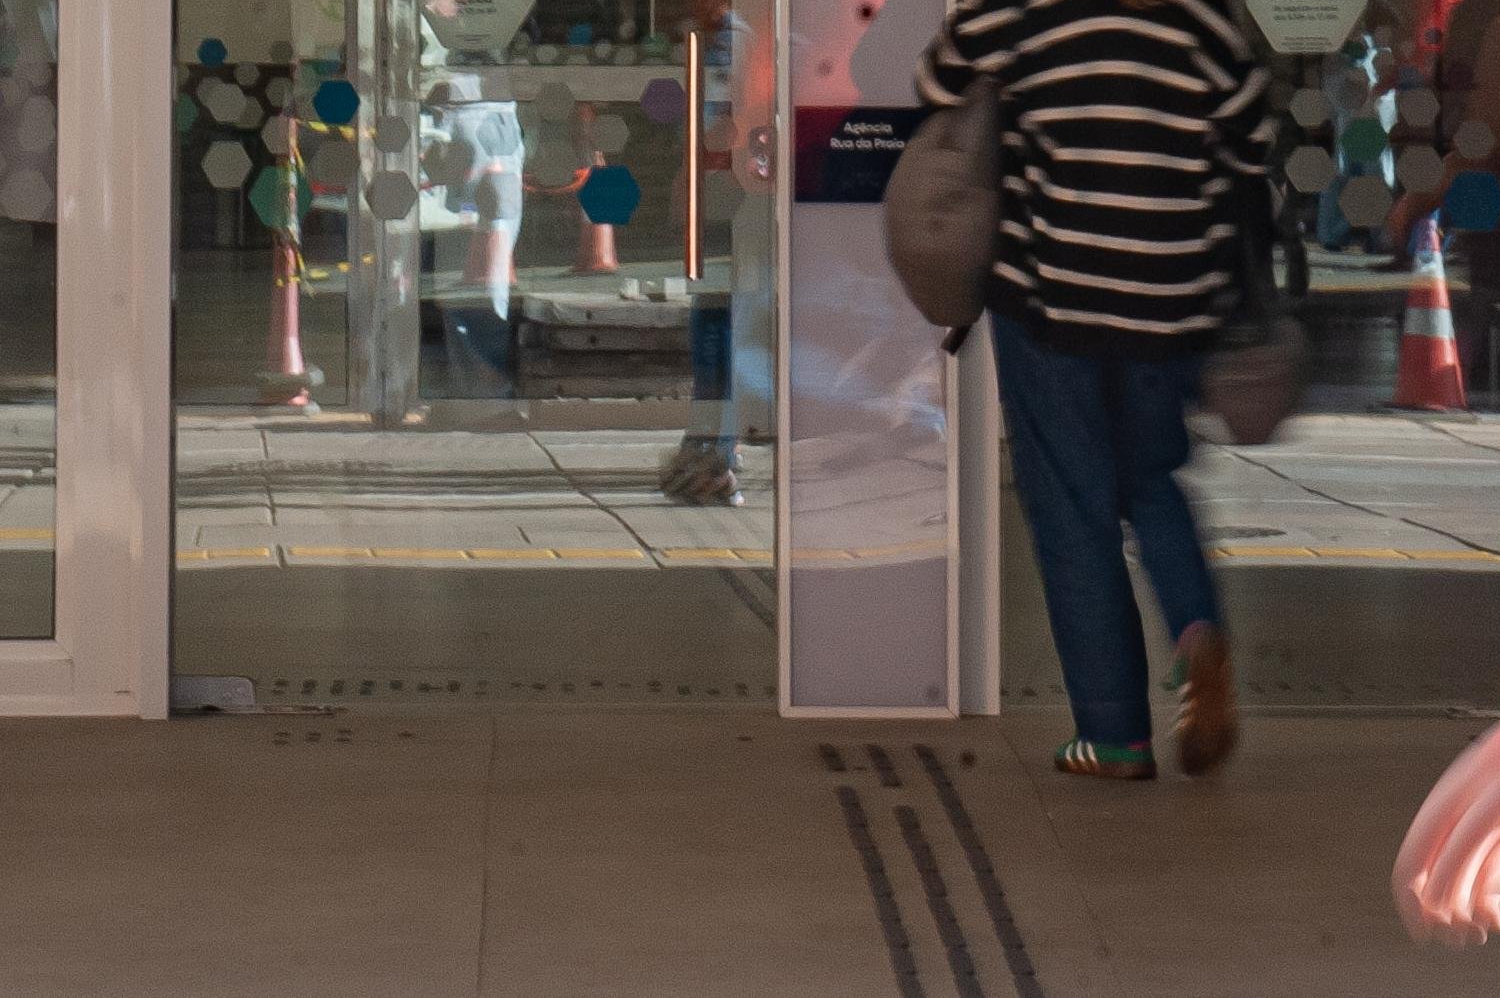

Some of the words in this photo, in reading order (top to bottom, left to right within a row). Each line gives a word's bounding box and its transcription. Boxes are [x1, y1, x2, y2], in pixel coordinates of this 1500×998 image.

[843, 121, 893, 135] Agência
[830, 137, 854, 150] Rua
[855, 137, 873, 150] da
